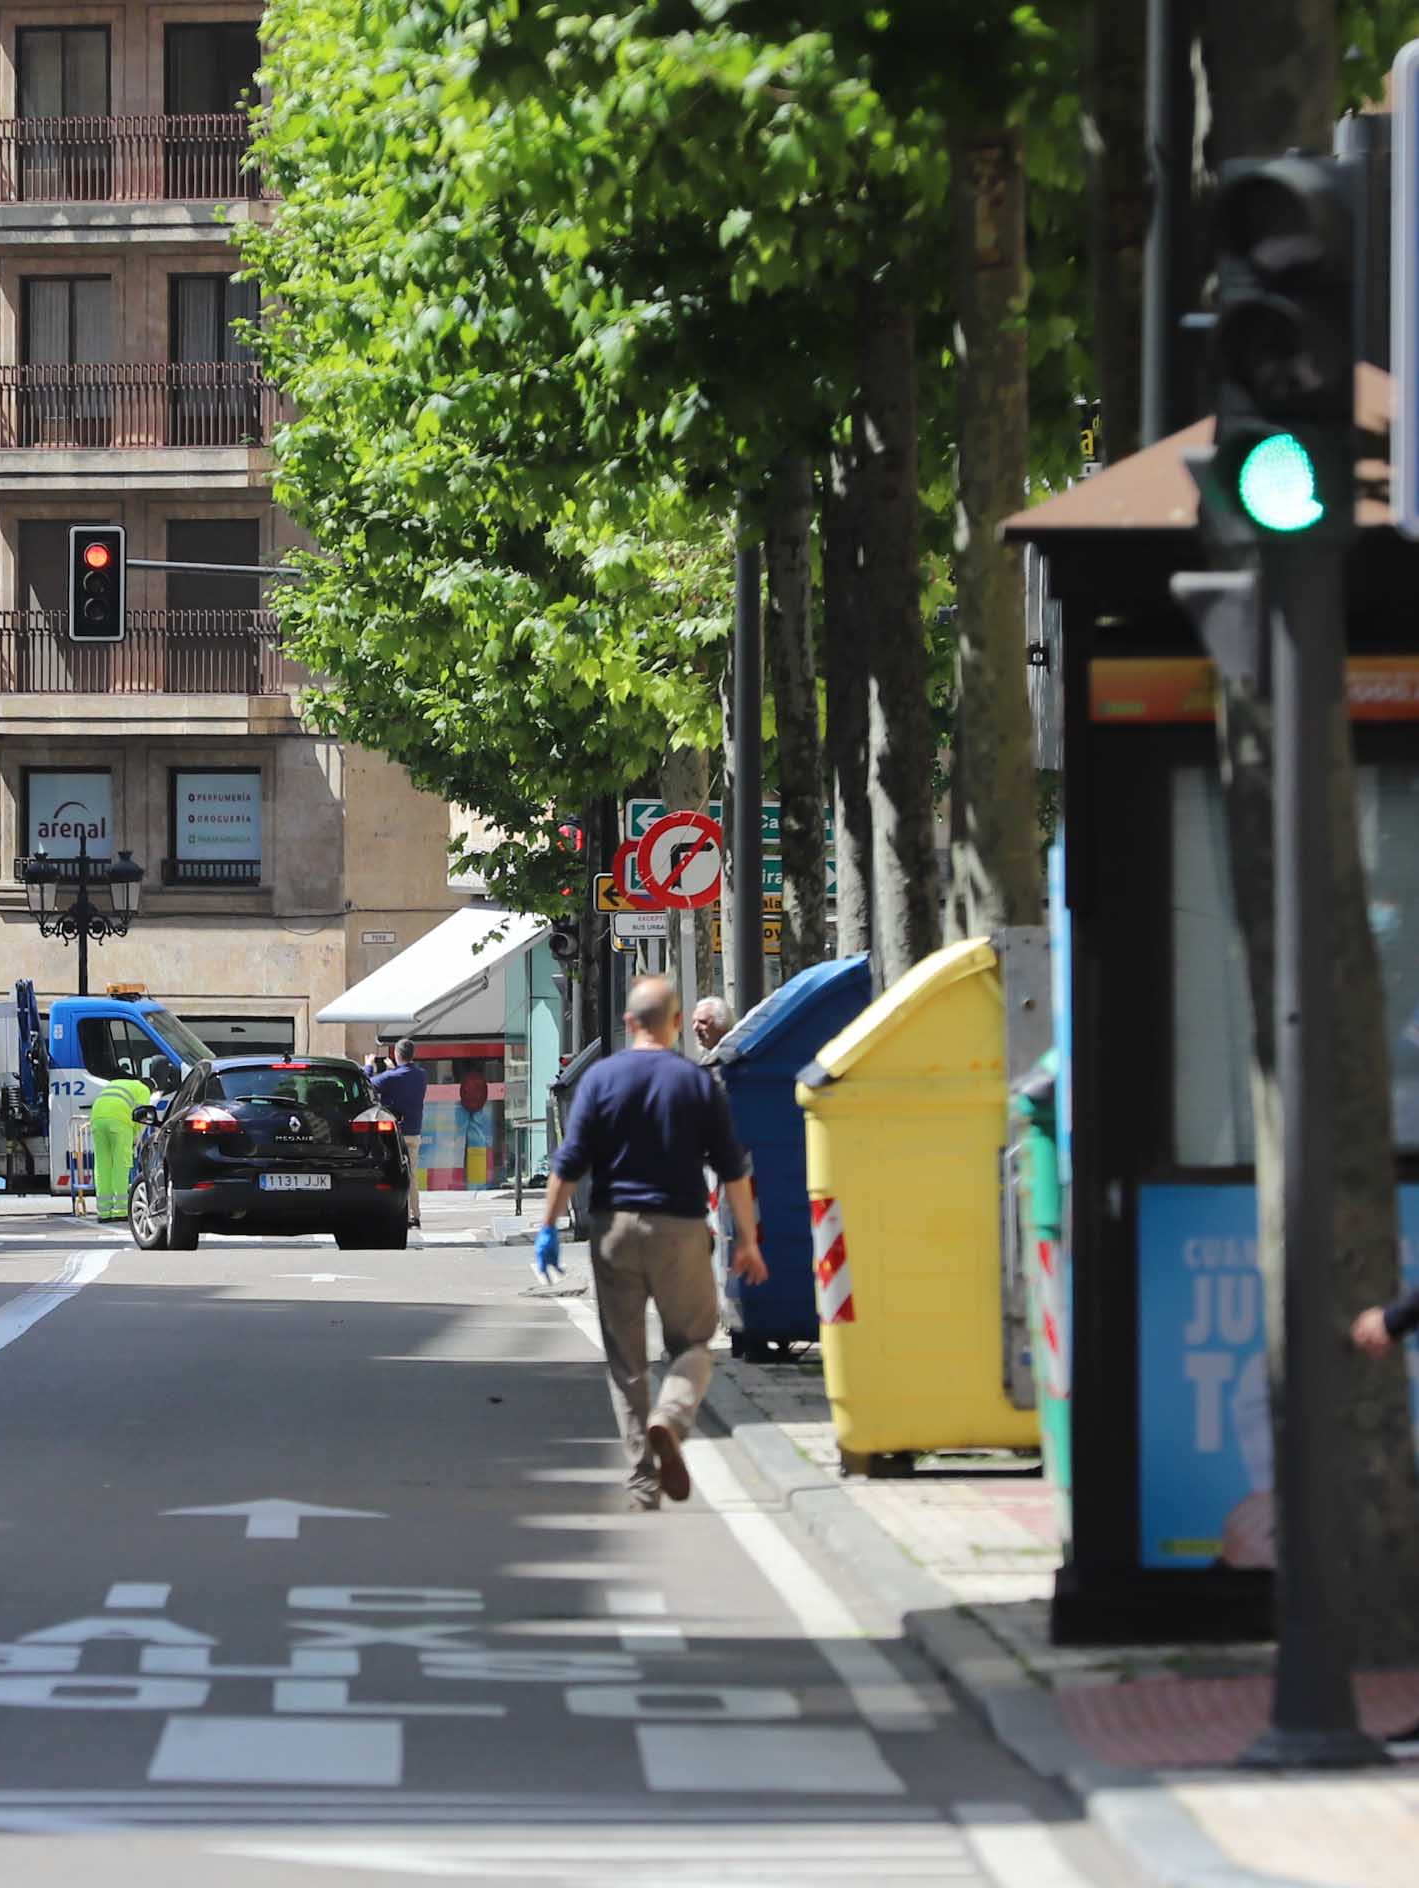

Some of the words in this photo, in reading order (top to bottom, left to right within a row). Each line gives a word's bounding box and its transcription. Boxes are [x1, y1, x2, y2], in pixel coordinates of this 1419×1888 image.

[197, 792, 251, 801] PERFUMERÍA
[197, 814, 251, 824] DROGUERÍA
[38, 817, 106, 839] arenal
[50, 1081, 86, 1096] 112
[269, 1176, 298, 1187] 1131
[304, 1176, 327, 1187] JJK
